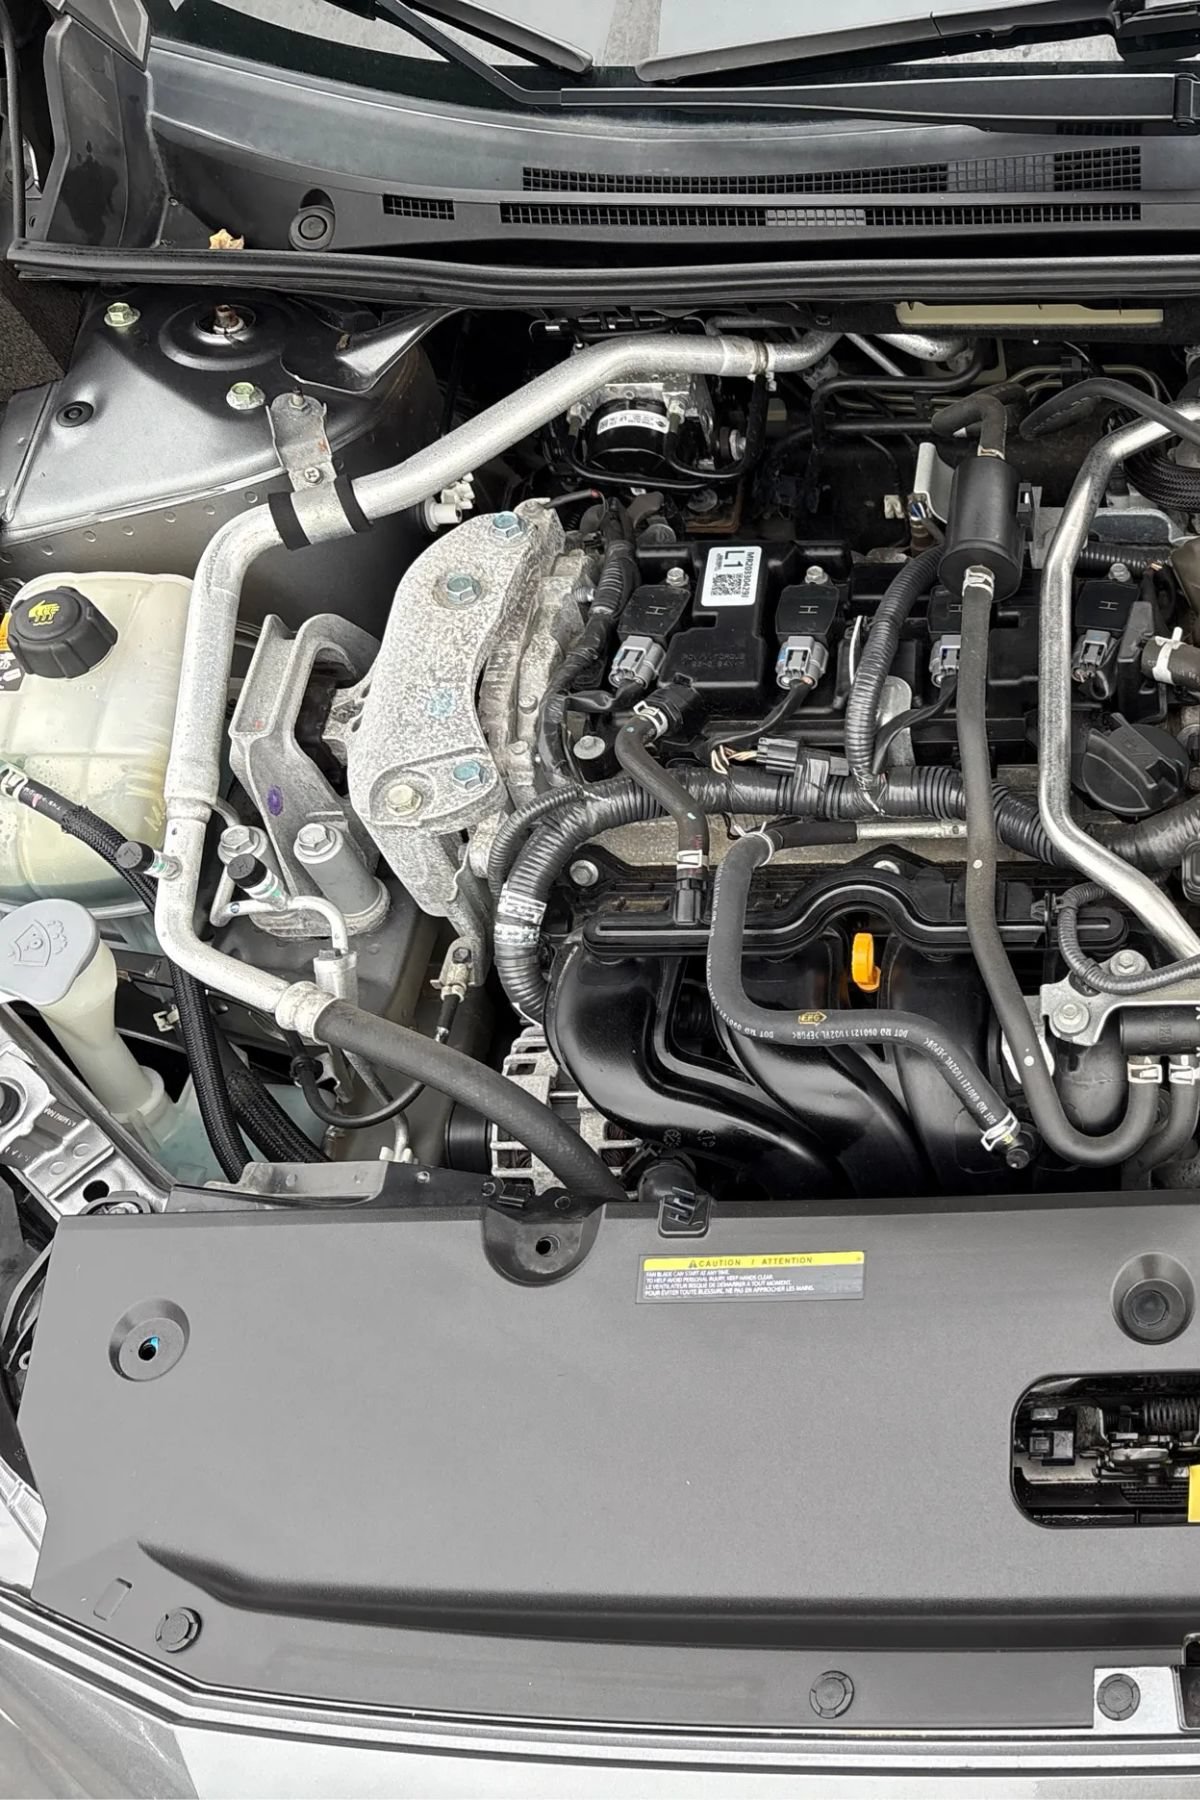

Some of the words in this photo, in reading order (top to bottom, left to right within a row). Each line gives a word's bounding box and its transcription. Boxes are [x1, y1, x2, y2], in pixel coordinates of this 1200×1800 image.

[723, 550, 745, 567] L1
[698, 1258, 741, 1268] CAUTION
[762, 1256, 813, 1265] ATTENTION
